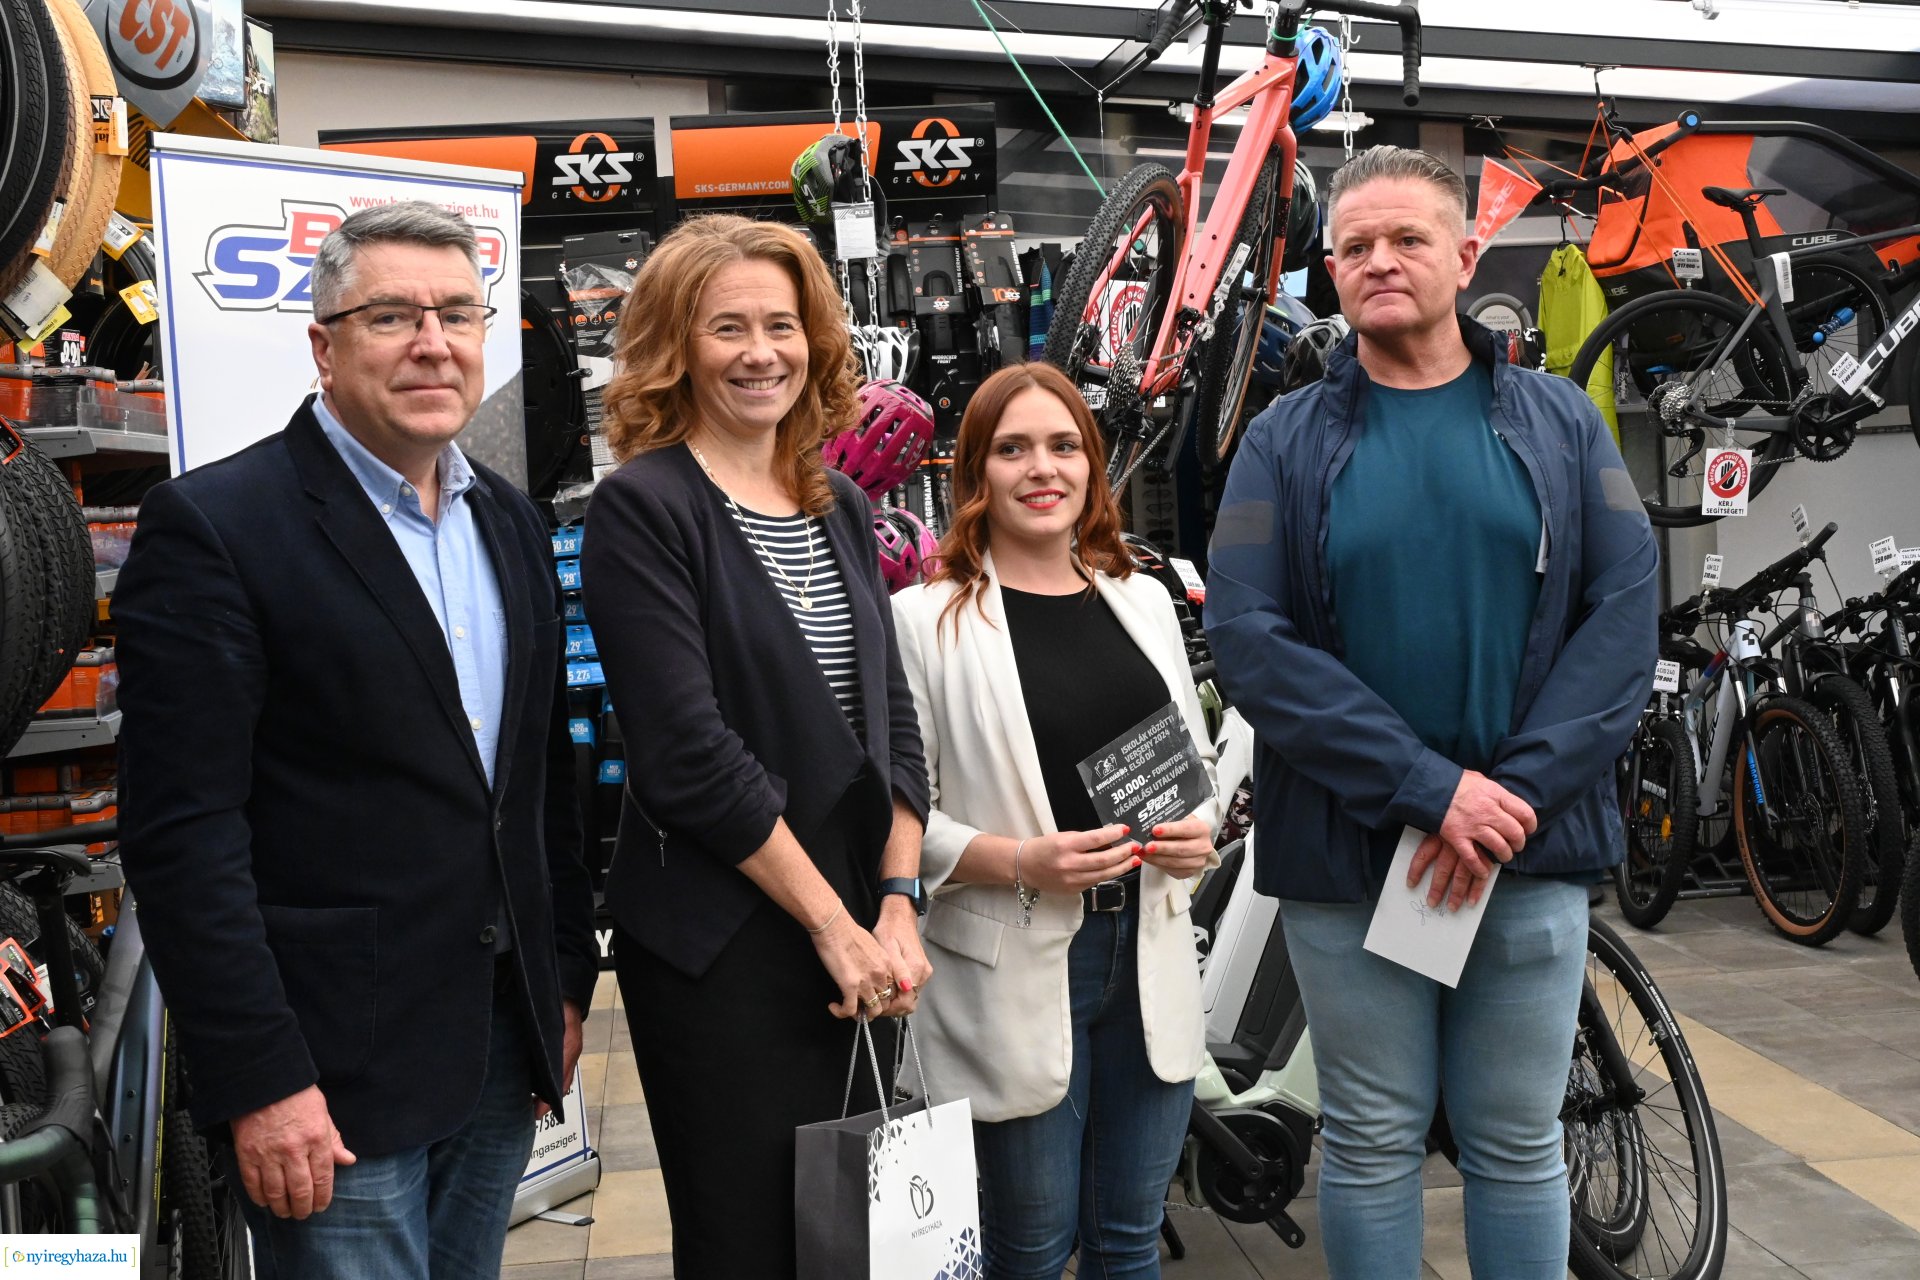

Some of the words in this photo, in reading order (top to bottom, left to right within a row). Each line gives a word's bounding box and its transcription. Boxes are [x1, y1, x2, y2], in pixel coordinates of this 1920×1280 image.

[694, 179, 790, 194] SKS-GERMANY.COM
[892, 173, 981, 184] GERMANY
[552, 187, 642, 199] GERMANY
[1792, 234, 1838, 247] CUBE
[1861, 299, 1920, 377] CUB
[923, 474, 935, 518] GERMANY
[1120, 733, 1149, 755] ISKOLÁK
[1148, 714, 1175, 736] KÖZÖTTI
[1124, 740, 1154, 763] VERSENY
[1153, 728, 1170, 745] 2024
[1129, 756, 1146, 772] ELSŐ
[1145, 749, 1156, 762] DÍJ
[1110, 774, 1151, 805] 30.000.-
[1151, 751, 1184, 778] FORINTOS
[1113, 788, 1154, 818] VÁSÁRLÁSI
[1152, 760, 1189, 792] UTALVÁNY
[1669, 1021, 1680, 1036] PRO
[530, 1131, 578, 1160] ingasziget
[911, 1220, 943, 1240] NYÍREGYHÁZA
